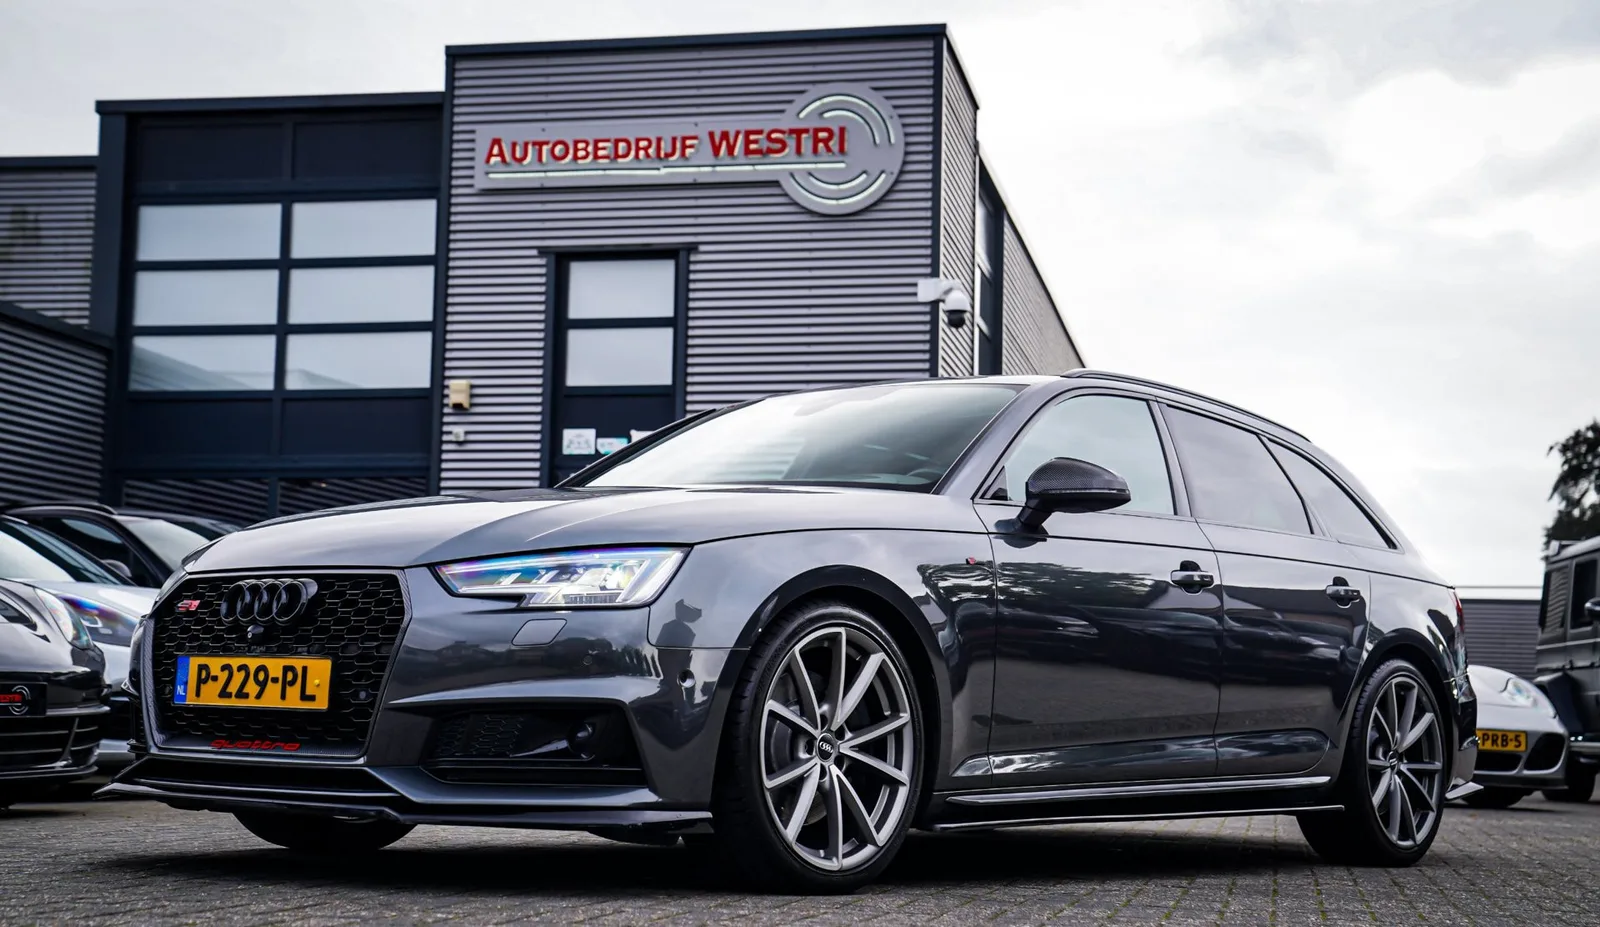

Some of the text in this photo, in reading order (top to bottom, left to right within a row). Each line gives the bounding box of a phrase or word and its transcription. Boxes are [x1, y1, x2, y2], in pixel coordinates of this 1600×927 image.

[485, 126, 847, 165] AUTOBEDRIJF WESTRI
[176, 685, 186, 696] NL
[195, 663, 316, 702] P-229-PL
[210, 739, 300, 751] quattro
